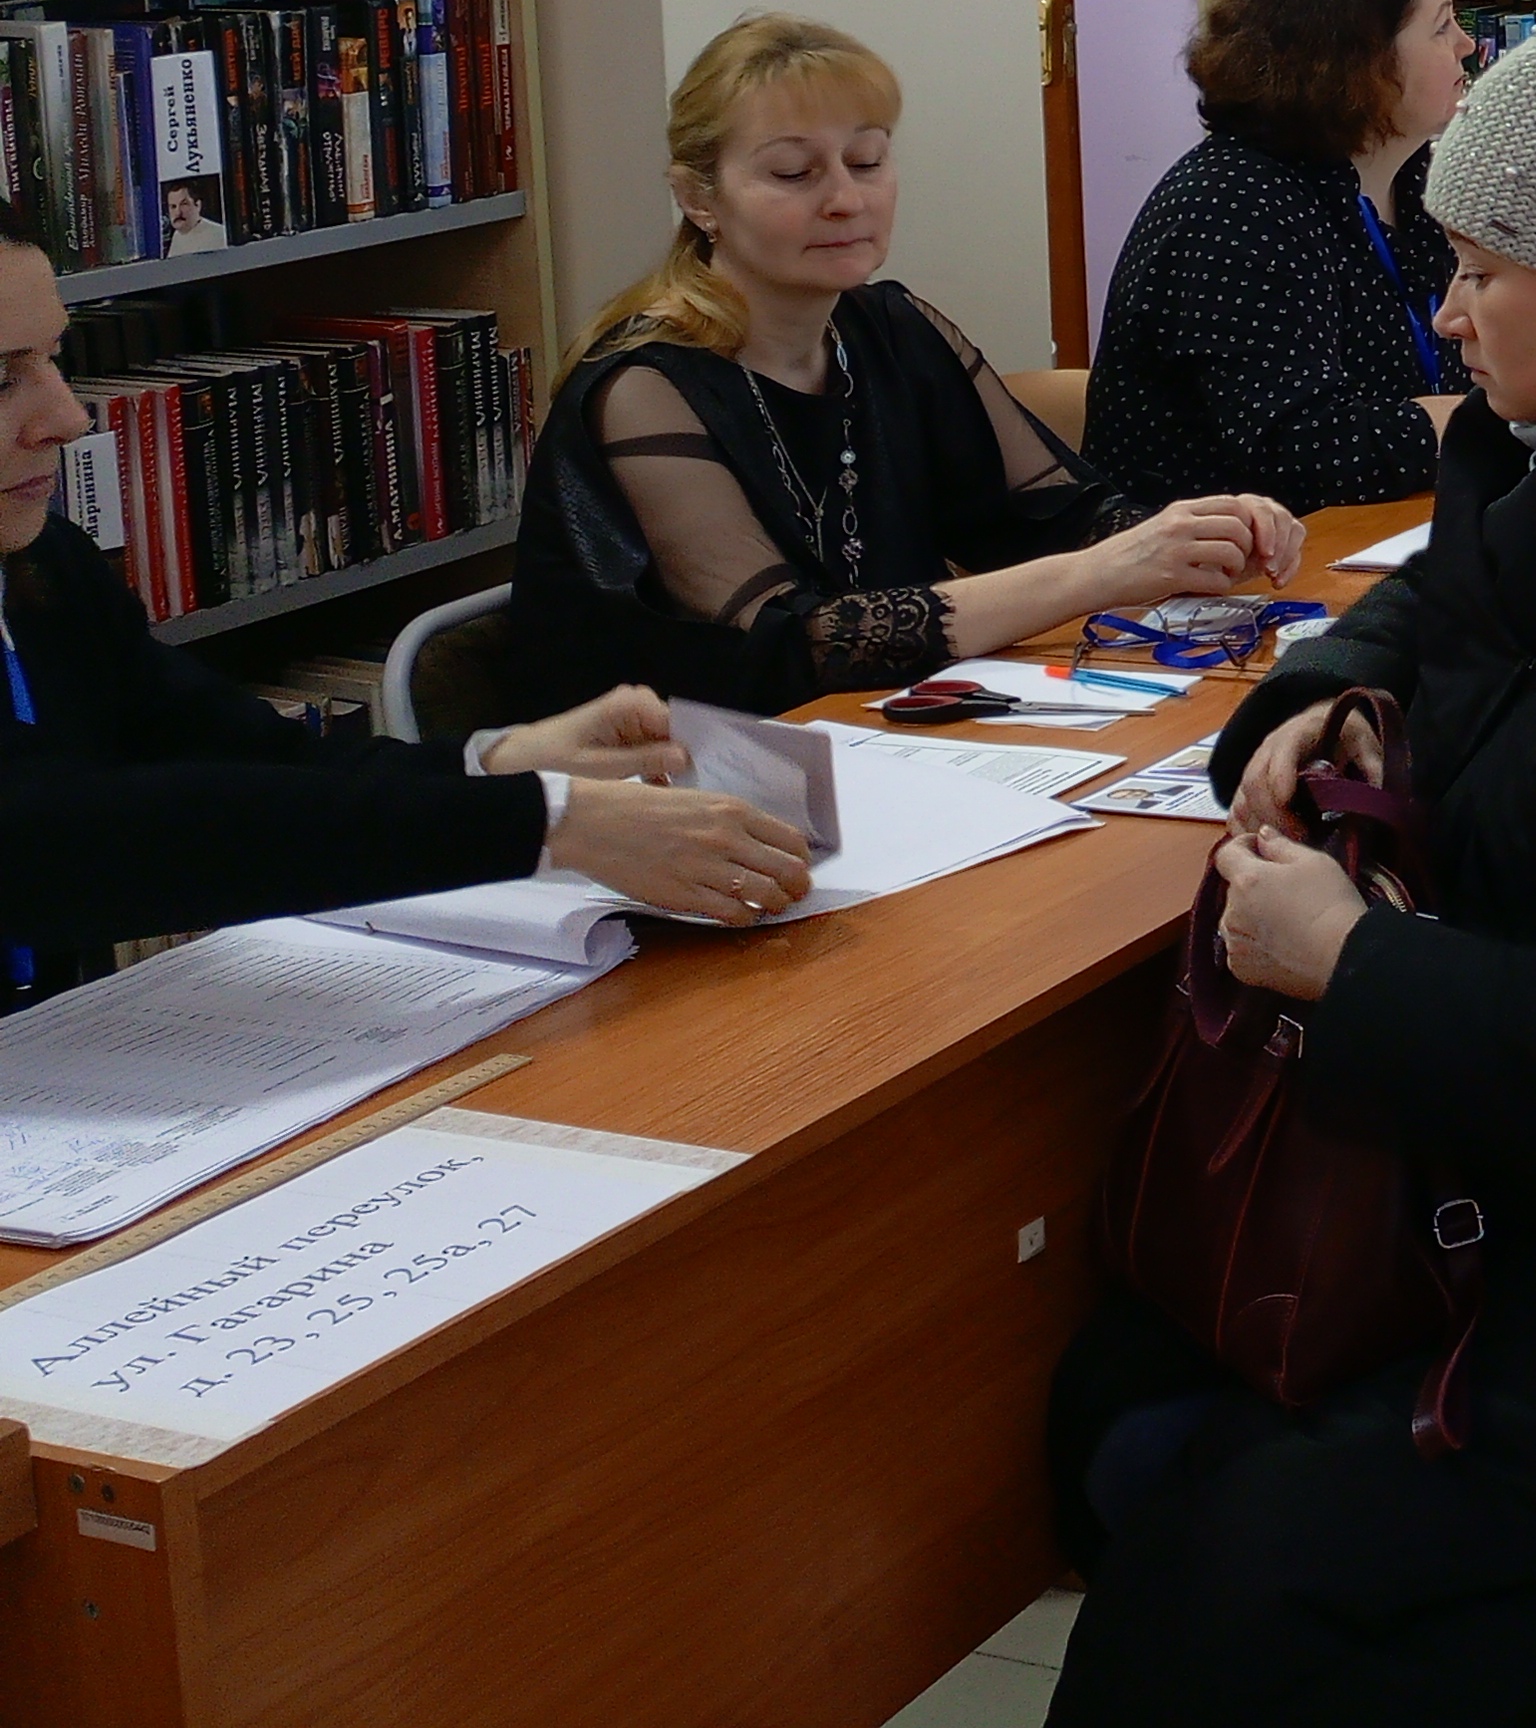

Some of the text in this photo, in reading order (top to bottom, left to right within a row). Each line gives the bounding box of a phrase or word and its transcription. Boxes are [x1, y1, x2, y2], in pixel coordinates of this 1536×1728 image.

[166, 83, 178, 154] Сергей
[183, 58, 205, 174] Лукьяненко
[470, 330, 486, 427] МАРИНИНА
[488, 326, 502, 422] МАРИНИНА
[228, 387, 243, 491] МАРИНИНА
[252, 382, 270, 487] МАРИНИНА
[277, 375, 292, 478] МАРИНИНА
[384, 418, 403, 541] А.МАРИНИНА
[30, 1149, 486, 1378] Аллейный переулок,
[479, 1203, 539, 1238] 27
[91, 1238, 395, 1393] ул. Гагарина
